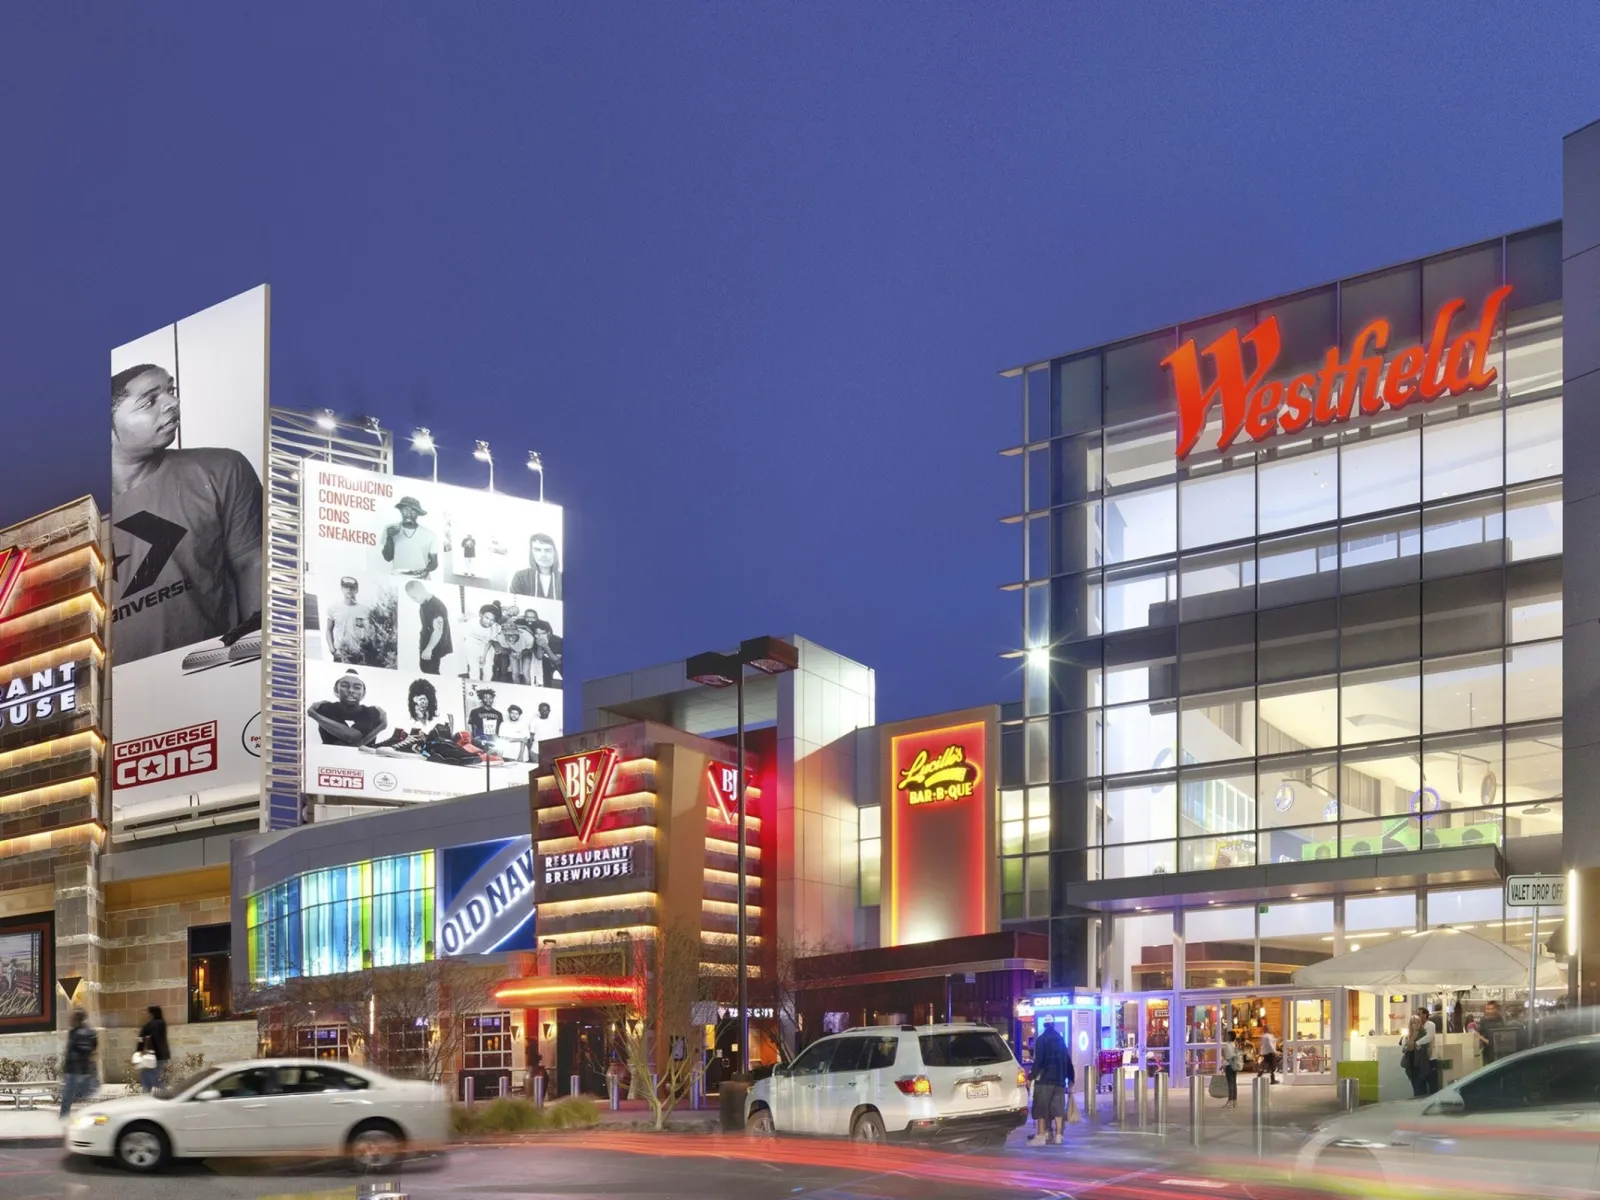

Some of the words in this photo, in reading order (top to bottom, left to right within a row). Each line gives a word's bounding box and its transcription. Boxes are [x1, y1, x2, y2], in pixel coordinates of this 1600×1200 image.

[1160, 284, 1513, 460] Westfield
[318, 471, 393, 498] INTRODUCING
[318, 488, 376, 512] CONVERSE
[318, 506, 350, 525] CONS
[318, 523, 377, 546] SNEAKERS
[0, 661, 76, 700] ANT
[0, 690, 76, 726] USE
[117, 725, 213, 758] CONVERSE
[320, 767, 361, 777] CONVERSE
[898, 745, 964, 789] Lucille's
[564, 756, 595, 809] BJ's
[545, 846, 629, 868] RESTAURANT
[545, 862, 629, 884] BREWHOUSE
[1511, 884, 1530, 901] VALET
[1532, 884, 1549, 900] DROP
[441, 898, 486, 954] OLD
